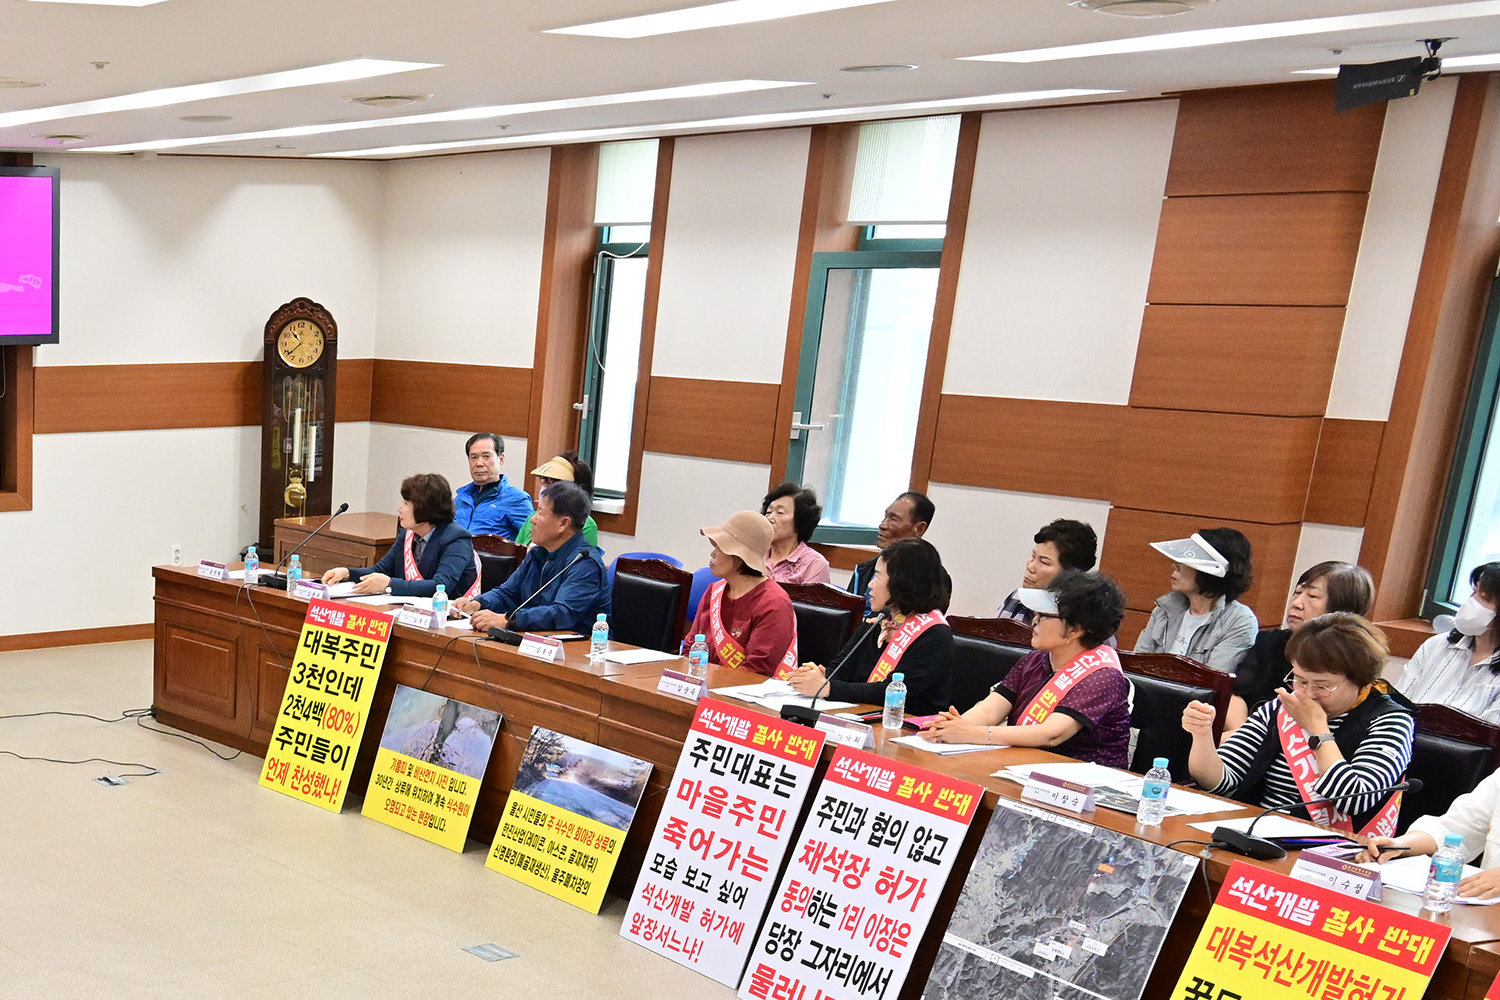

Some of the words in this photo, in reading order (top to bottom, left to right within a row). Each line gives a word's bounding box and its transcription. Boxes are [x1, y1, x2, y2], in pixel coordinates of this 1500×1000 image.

[309, 605, 346, 626] 석산개발
[346, 614, 367, 632] 결사
[367, 619, 389, 638] 반대
[887, 612, 934, 660] 석산개발
[303, 629, 381, 670] 대복주민
[1053, 649, 1114, 691] 석산개발
[293, 662, 364, 702] 3천인데
[1029, 689, 1057, 723] 반대
[283, 694, 361, 739] 2천4백(80%)
[699, 707, 751, 740] 석산개발
[751, 724, 783, 750] 결사
[783, 734, 818, 761] 반대
[275, 725, 351, 771] 주민들이
[689, 737, 797, 799] 주민대표는
[265, 756, 289, 785] 언제
[290, 764, 342, 805] 찬성했냐!
[375, 774, 394, 790] 30년간
[395, 780, 412, 797] 상류에
[412, 786, 434, 805] 위치하여
[434, 794, 446, 809] 계속
[447, 798, 471, 818] 식수원이
[407, 763, 414, 777] 및
[414, 766, 437, 785] 비산먼지
[436, 773, 449, 789] 사진
[448, 777, 467, 795] 입니다.
[833, 756, 896, 791] 석산개발
[897, 775, 932, 802] 결사
[938, 788, 974, 817] 반대
[384, 798, 406, 817] 오염되고
[406, 806, 418, 822] 있는
[417, 810, 446, 832] 현장입니다.
[509, 801, 524, 819] 울산
[522, 806, 549, 828] 시민들의
[547, 815, 555, 830] 주
[555, 818, 575, 839] 식수인
[573, 826, 595, 846] 회야강
[594, 834, 617, 854] 상류의
[676, 778, 787, 840] 마을주민
[817, 796, 869, 840] 주민과
[868, 811, 908, 854] 협의
[908, 826, 949, 866] 않고
[547, 840, 568, 862] 아스콘,
[663, 816, 770, 882] 죽어가는
[650, 852, 678, 881] 모습
[682, 864, 712, 894] 보고
[717, 879, 749, 910] 싶어
[798, 838, 871, 890] 채석장
[875, 865, 928, 912] 허가
[1329, 875, 1364, 895] 이수정
[629, 911, 704, 964] 앞장서느냐!
[642, 882, 695, 923] 석산개발
[699, 908, 746, 945] 허가에
[780, 879, 838, 929] 동의하는
[837, 903, 862, 940] 1리
[862, 913, 912, 959] 이장은
[1229, 875, 1320, 927] 석산개발
[1321, 908, 1375, 943] 결사
[1382, 926, 1436, 965] 반대
[764, 921, 802, 962] 당장
